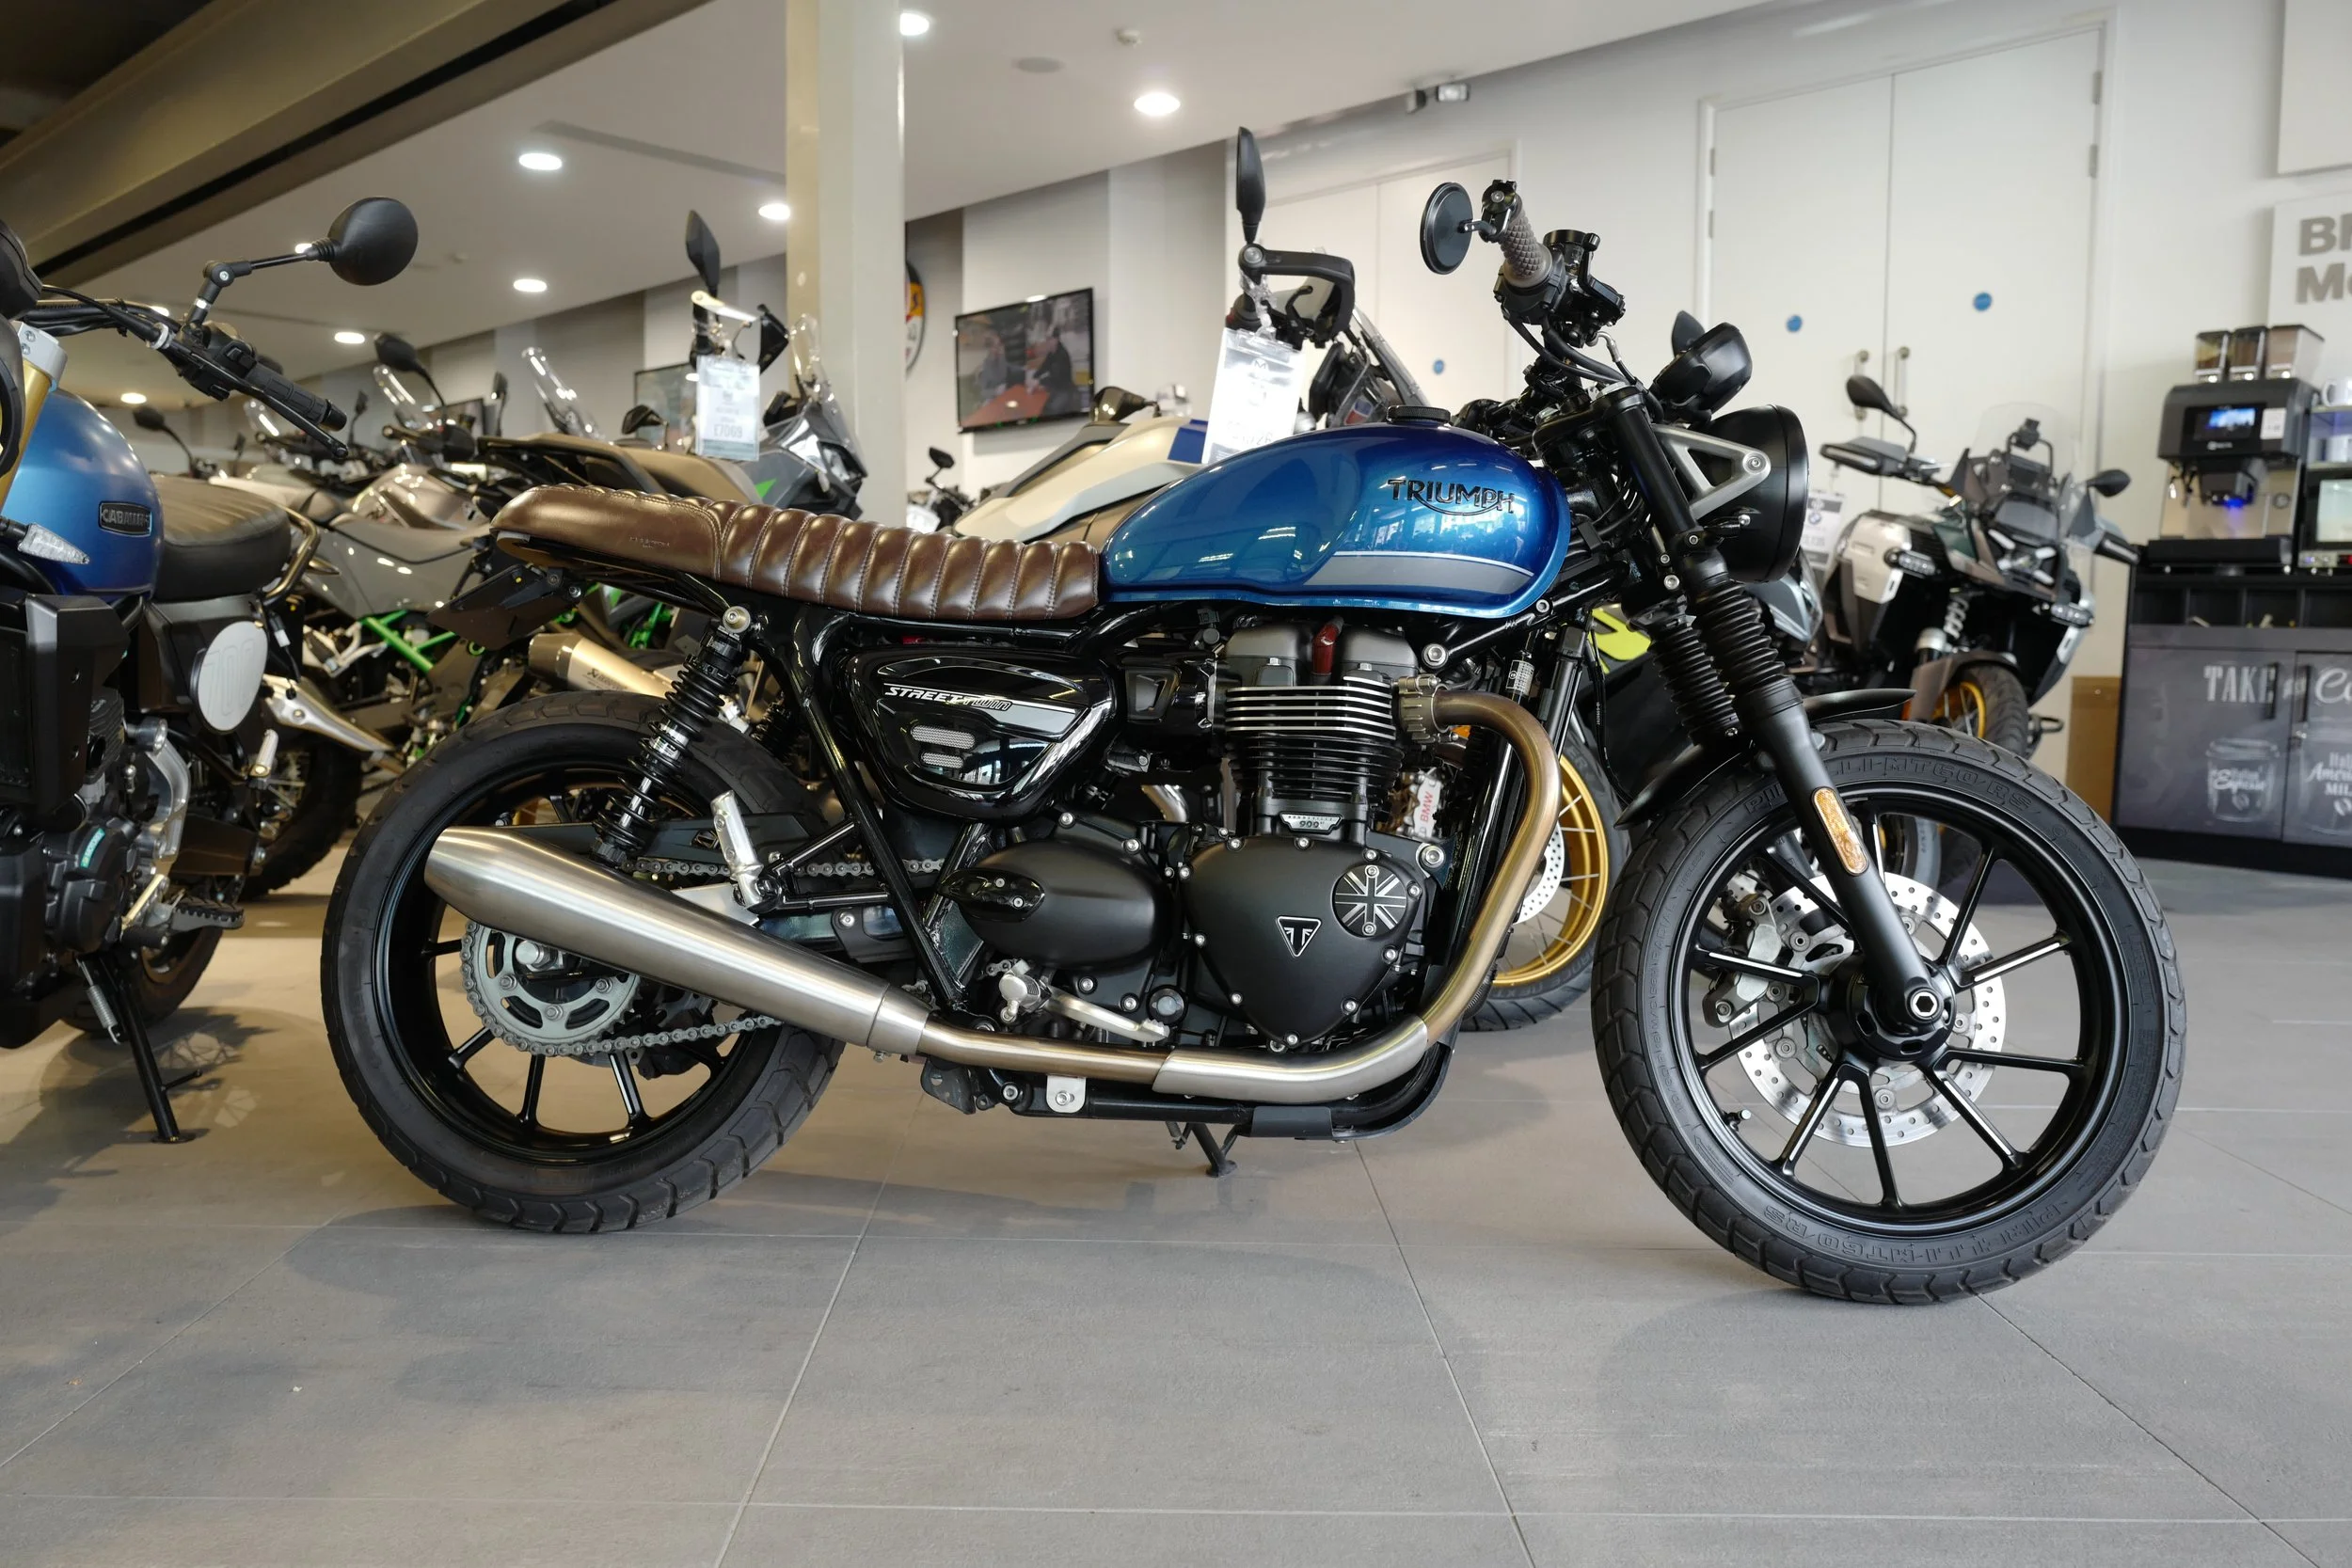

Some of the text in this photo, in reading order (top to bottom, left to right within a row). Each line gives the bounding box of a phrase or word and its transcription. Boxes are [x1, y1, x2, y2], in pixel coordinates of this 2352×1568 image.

[2296, 263, 2352, 303] M
[1388, 478, 1515, 515] TRIUMPH
[885, 687, 963, 705] STREET
[1420, 791, 1434, 824] BMW
[1299, 820, 1320, 829] 900
